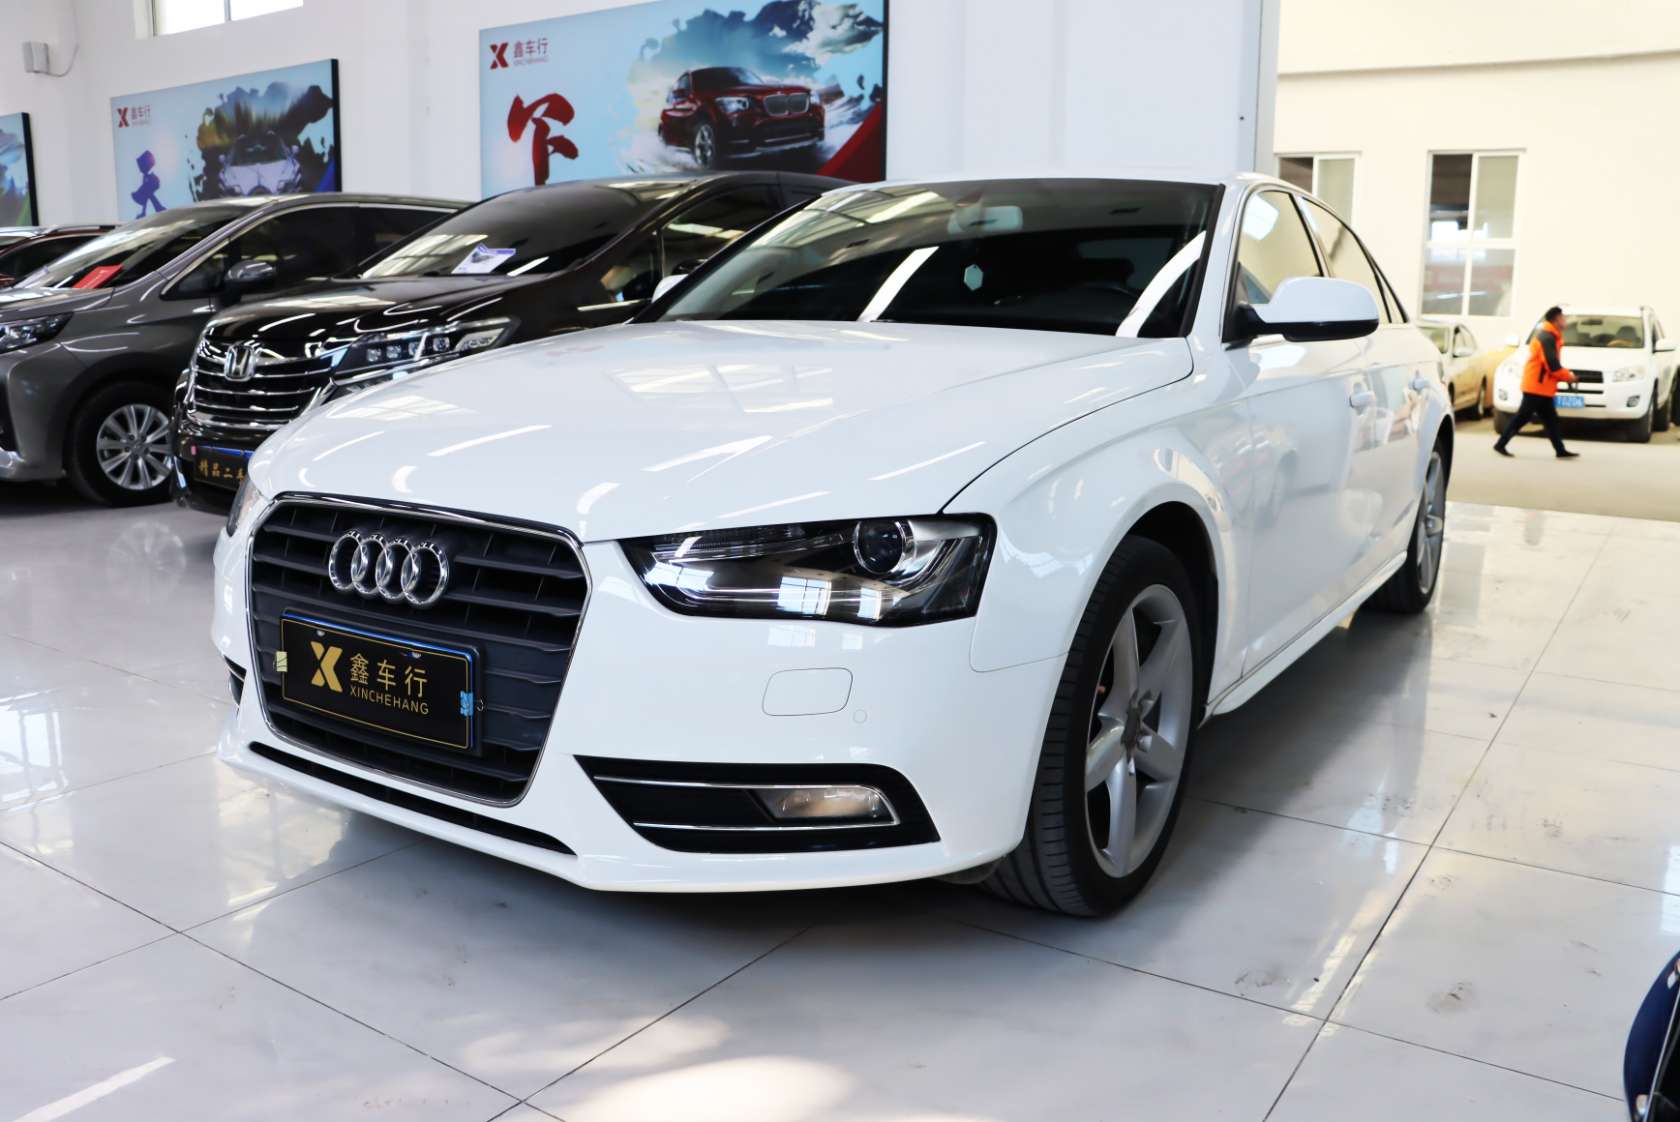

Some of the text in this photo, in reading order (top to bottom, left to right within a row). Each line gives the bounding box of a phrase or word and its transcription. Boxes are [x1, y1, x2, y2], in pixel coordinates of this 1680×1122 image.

[513, 37, 548, 58] 鑫车行
[350, 652, 428, 698] 鑫车行
[350, 685, 430, 715] XINCHEHANG
